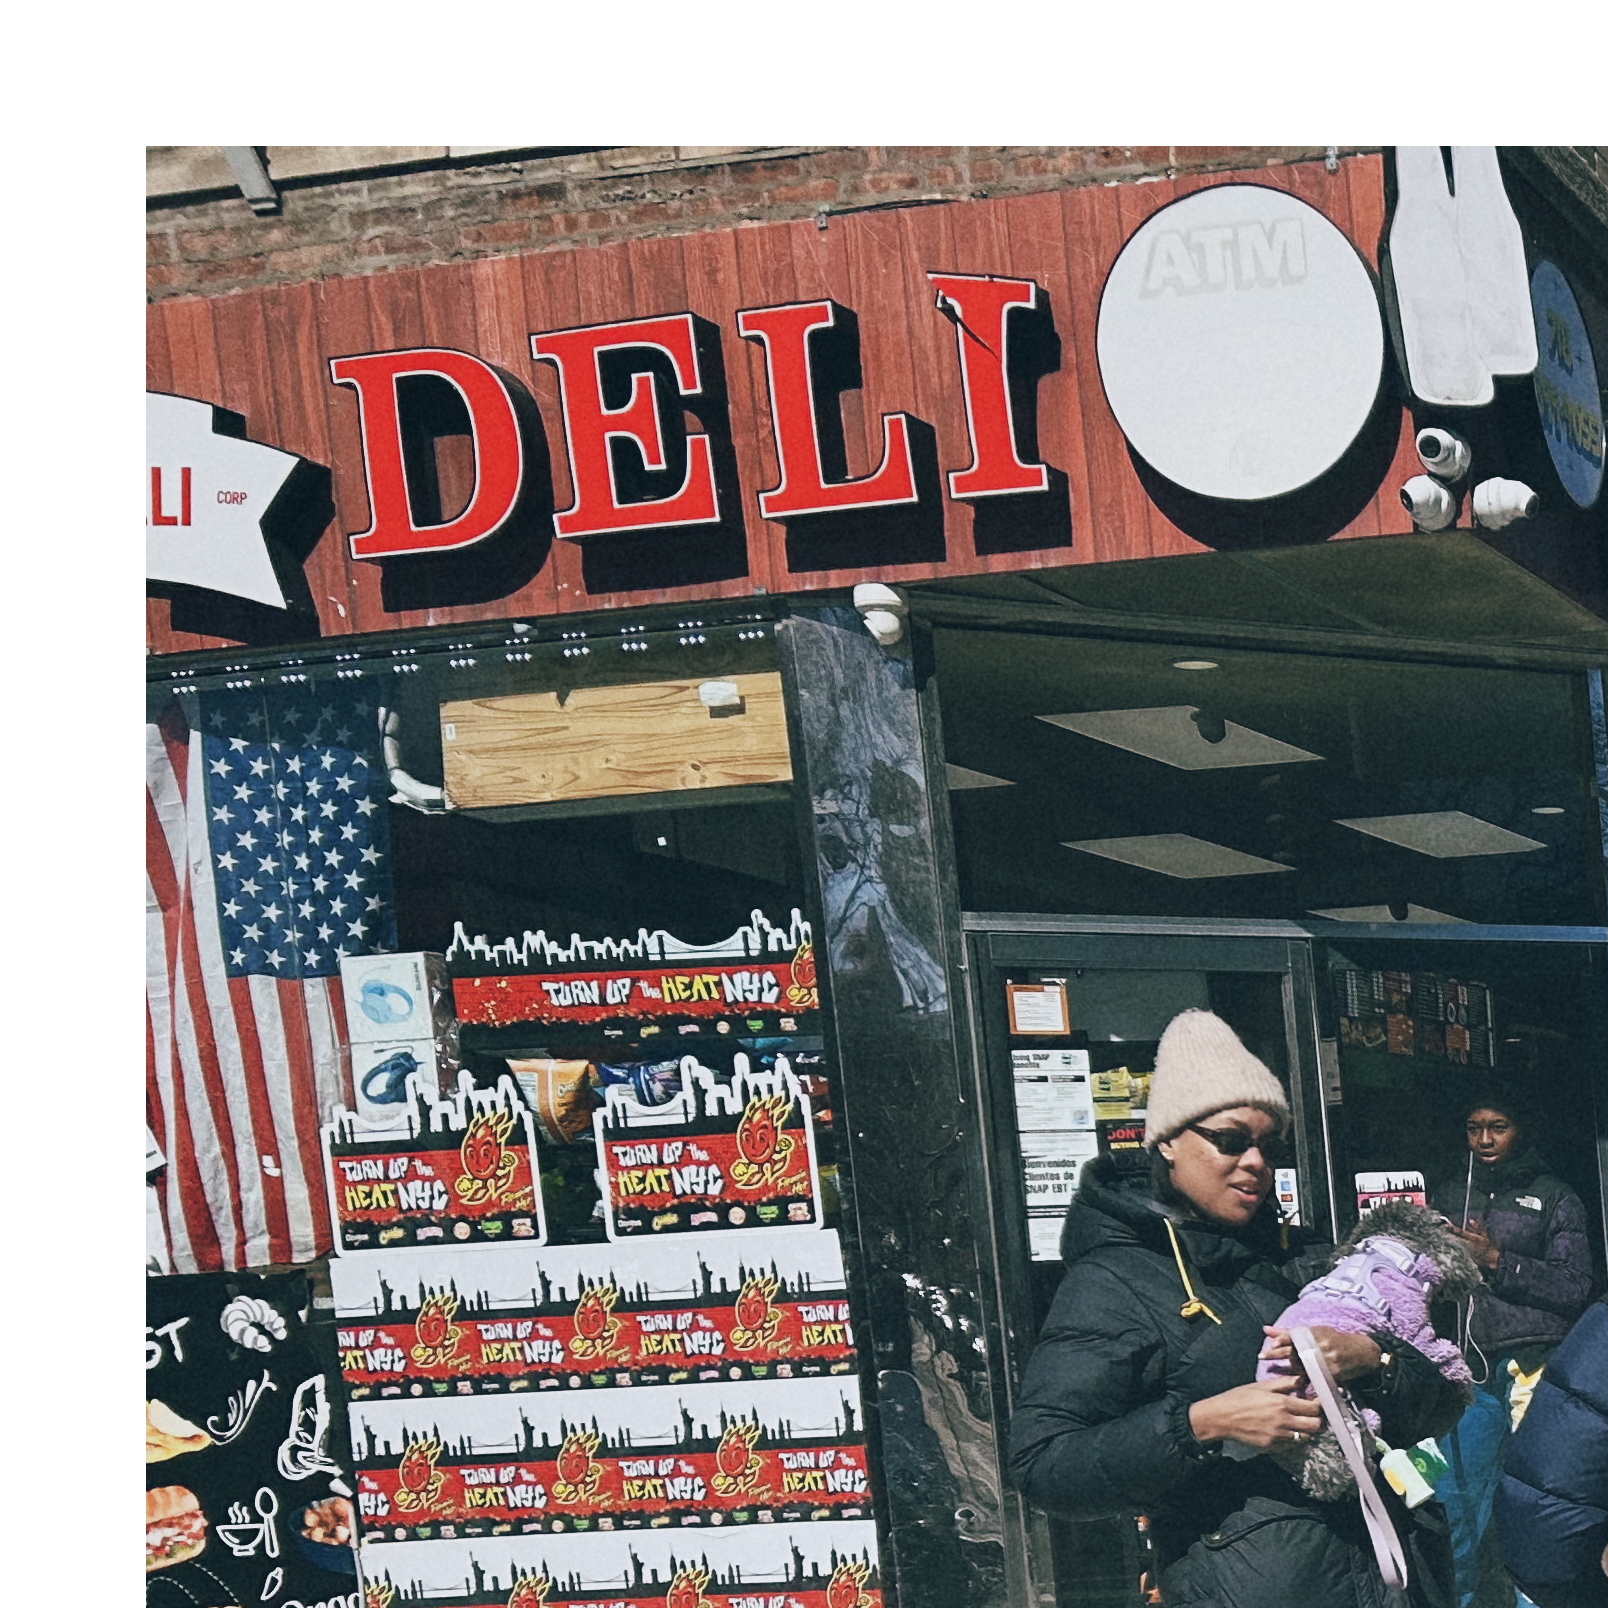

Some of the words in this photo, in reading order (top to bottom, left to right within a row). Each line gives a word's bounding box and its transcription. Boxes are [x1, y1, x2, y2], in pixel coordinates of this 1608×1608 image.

[1138, 217, 1308, 301] ATM
[329, 271, 1049, 561] DELI
[146, 466, 191, 526] LI
[217, 490, 248, 505] CORP
[541, 979, 600, 1006] TURN
[605, 977, 631, 1003] UP
[636, 980, 662, 999] the
[660, 973, 720, 1003] HEAT
[721, 970, 780, 1003] NYC
[611, 1144, 660, 1167] TURN
[661, 1141, 684, 1166] UP
[686, 1143, 710, 1162] the
[338, 1158, 384, 1182] TURN
[387, 1156, 409, 1180] UP
[411, 1158, 435, 1177] the
[616, 1167, 670, 1197] HEAT
[670, 1164, 725, 1196] NYC
[344, 1182, 396, 1212] HEAT
[397, 1179, 450, 1211] NYC
[635, 1315, 673, 1332] TURN
[675, 1312, 693, 1331] UP
[797, 1304, 835, 1322] TURN
[358, 1329, 375, 1347] UP
[477, 1323, 513, 1340] TURN
[516, 1321, 533, 1339] UP
[640, 1332, 683, 1356] HEAT
[683, 1330, 726, 1356] NYC
[801, 1323, 844, 1347] HEAT
[365, 1348, 406, 1372] NYC
[480, 1341, 523, 1364] HEAT
[523, 1340, 565, 1364] NYC
[618, 1460, 655, 1477] TURN
[658, 1458, 675, 1476] UP
[778, 1452, 816, 1470] TURN
[818, 1449, 835, 1468] UP
[459, 1468, 496, 1485] TURN
[499, 1466, 516, 1484] UP
[782, 1470, 824, 1493] HEAT
[824, 1468, 868, 1493] NYC
[464, 1486, 505, 1509] HEAT
[505, 1484, 547, 1509] NYC
[622, 1478, 664, 1501] HEAT
[664, 1476, 708, 1501] NYC
